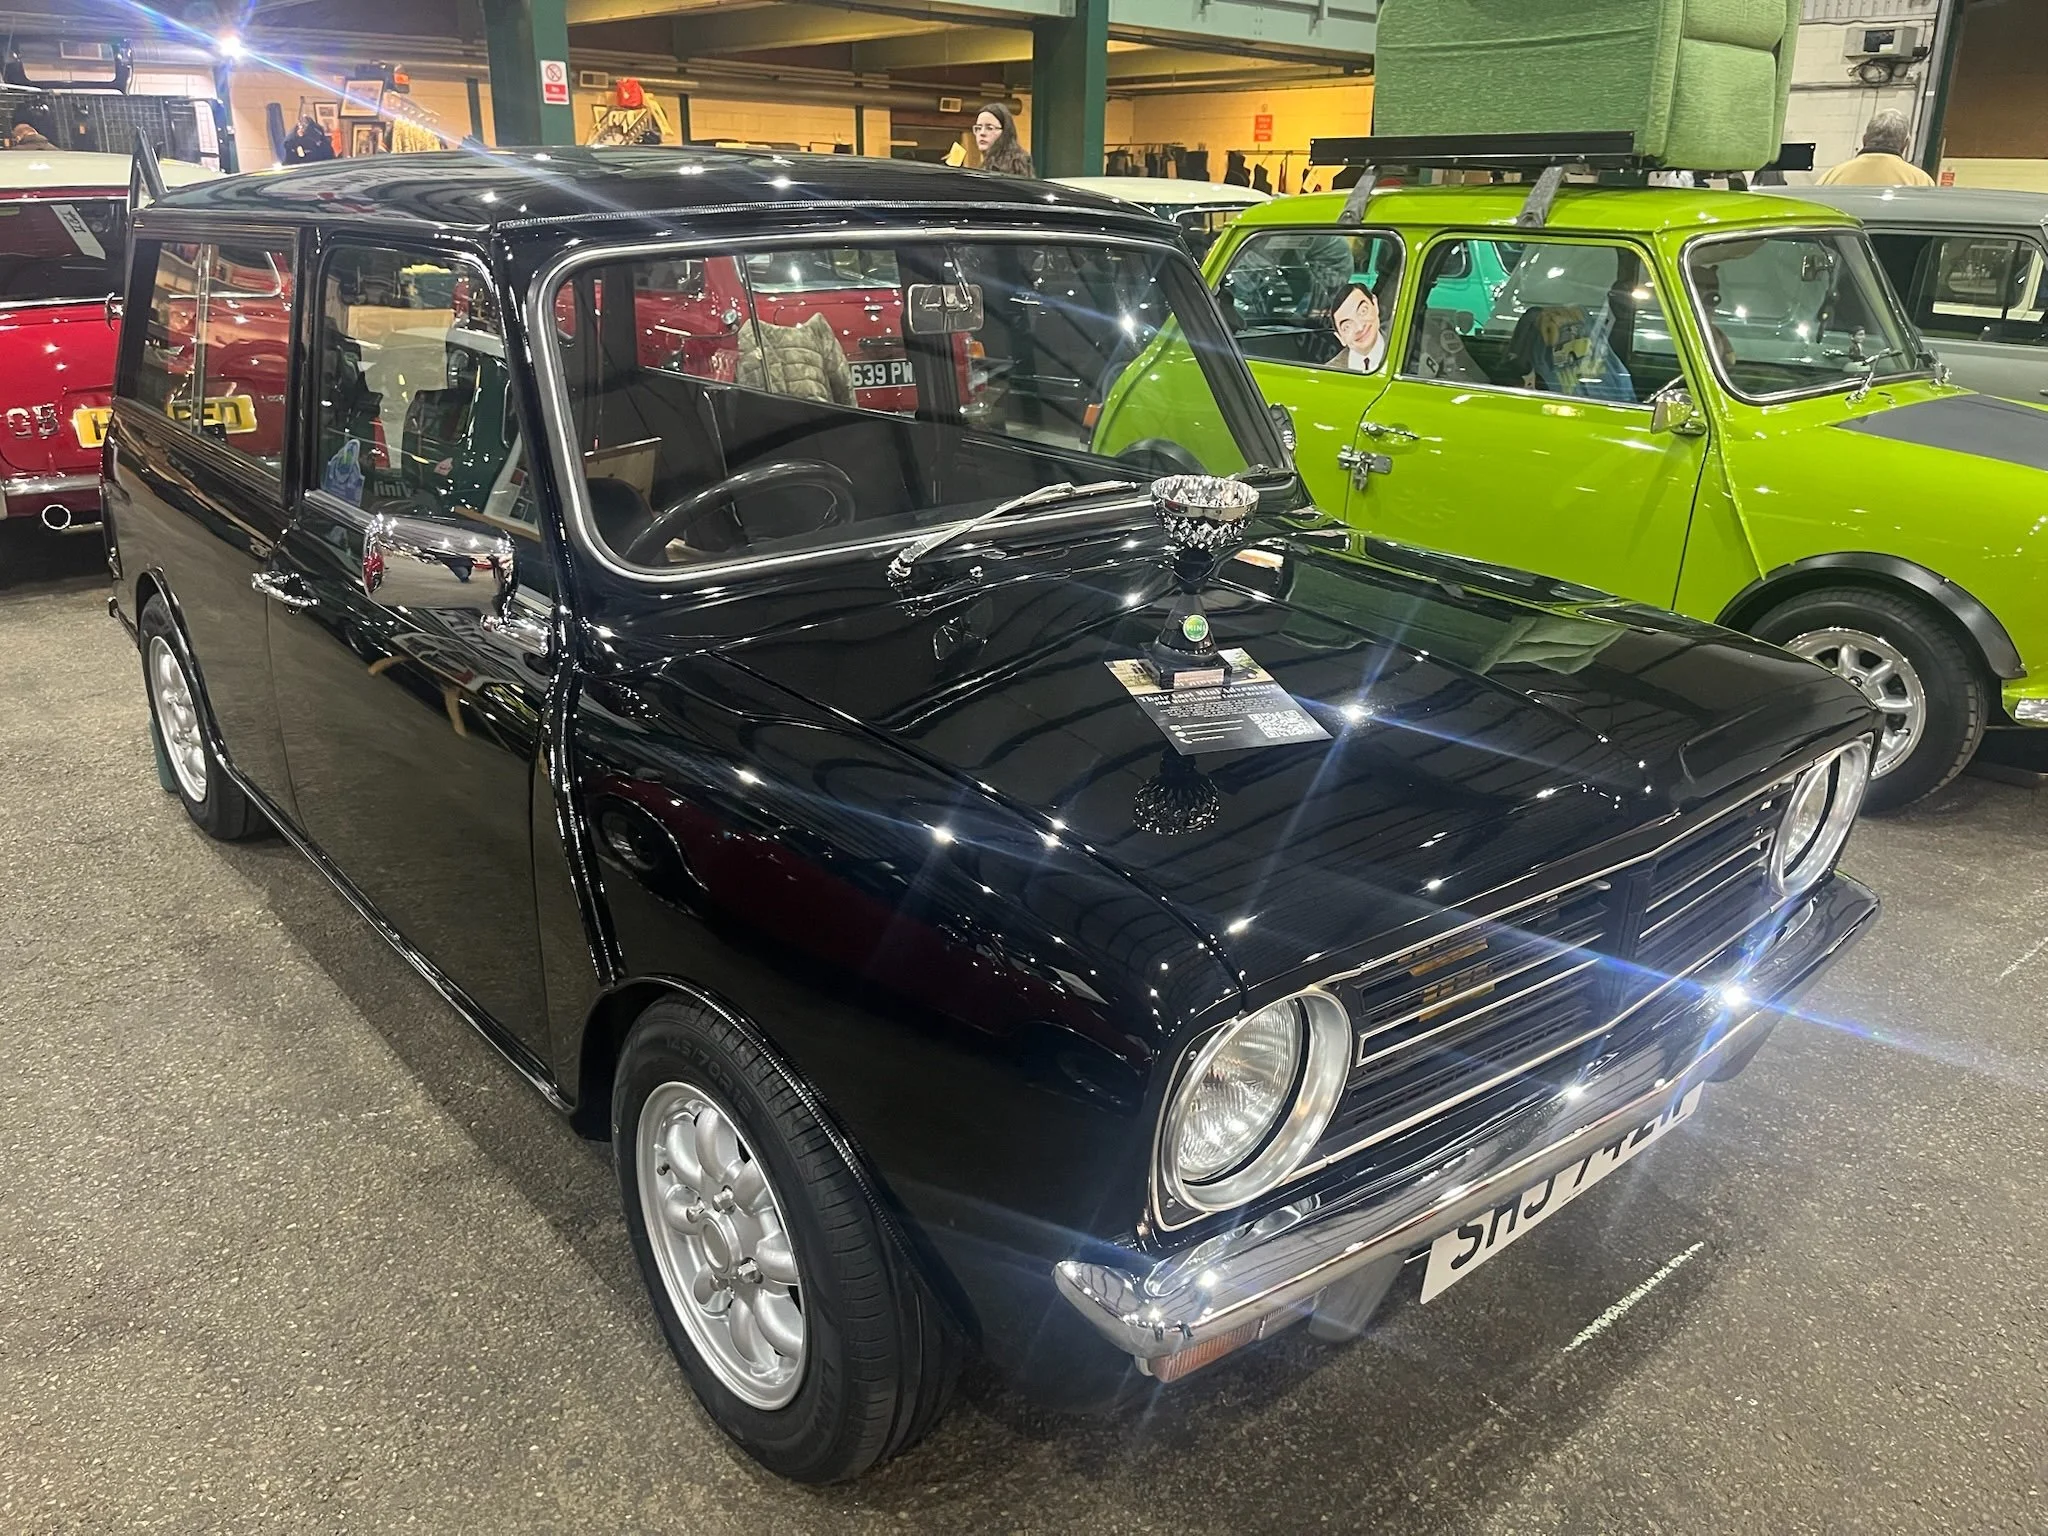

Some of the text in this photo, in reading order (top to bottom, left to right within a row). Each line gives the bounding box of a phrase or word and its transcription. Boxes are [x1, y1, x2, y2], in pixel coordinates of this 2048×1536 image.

[851, 361, 914, 386] 639 PW
[1138, 683, 1278, 703] Their Last Mini Adventure
